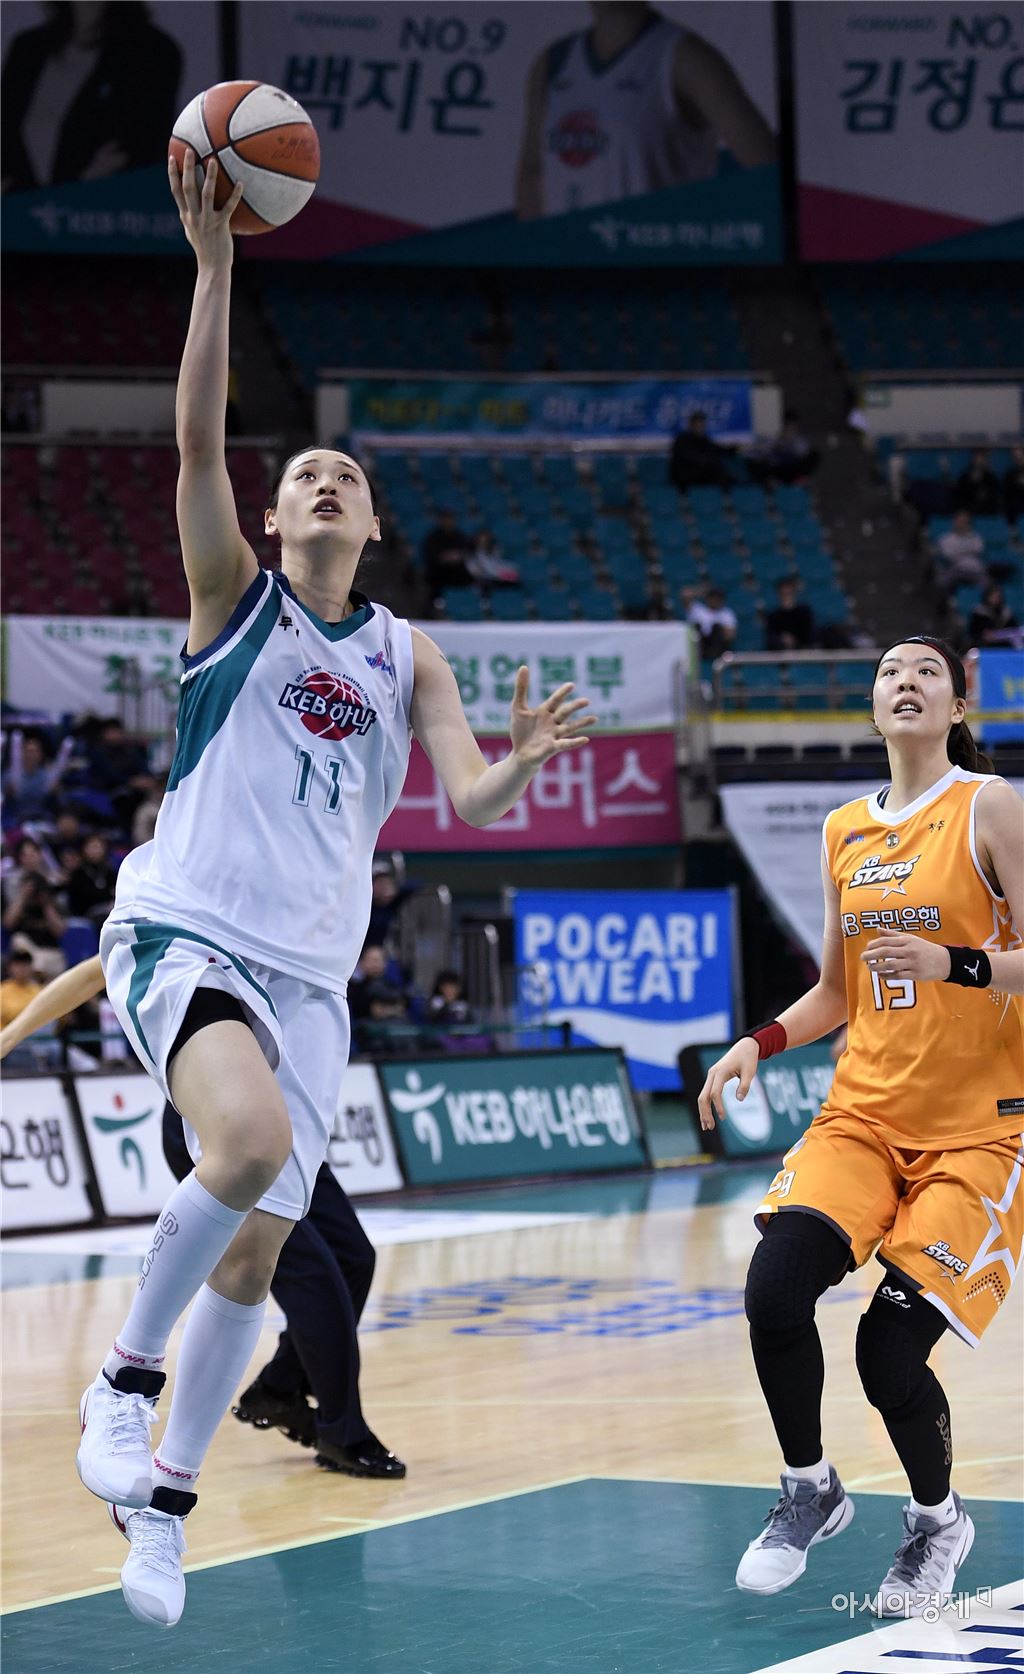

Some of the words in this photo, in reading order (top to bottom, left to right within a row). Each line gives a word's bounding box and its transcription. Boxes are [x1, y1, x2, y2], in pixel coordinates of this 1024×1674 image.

[400, 16, 507, 54] NO.9
[284, 54, 496, 134] 백지은
[279, 684, 327, 716] KEB
[329, 701, 376, 736] 하나
[292, 744, 346, 815] 11
[848, 856, 921, 889] STARS
[861, 854, 881, 868] KB
[522, 912, 717, 961] POCARI
[860, 904, 942, 932] 국민은행
[521, 958, 701, 1005] SWEAT
[445, 1089, 516, 1146] KEB
[510, 1083, 631, 1150] 하나은행
[138, 1229, 165, 1291] SKINS
[922, 1245, 969, 1273] STARS
